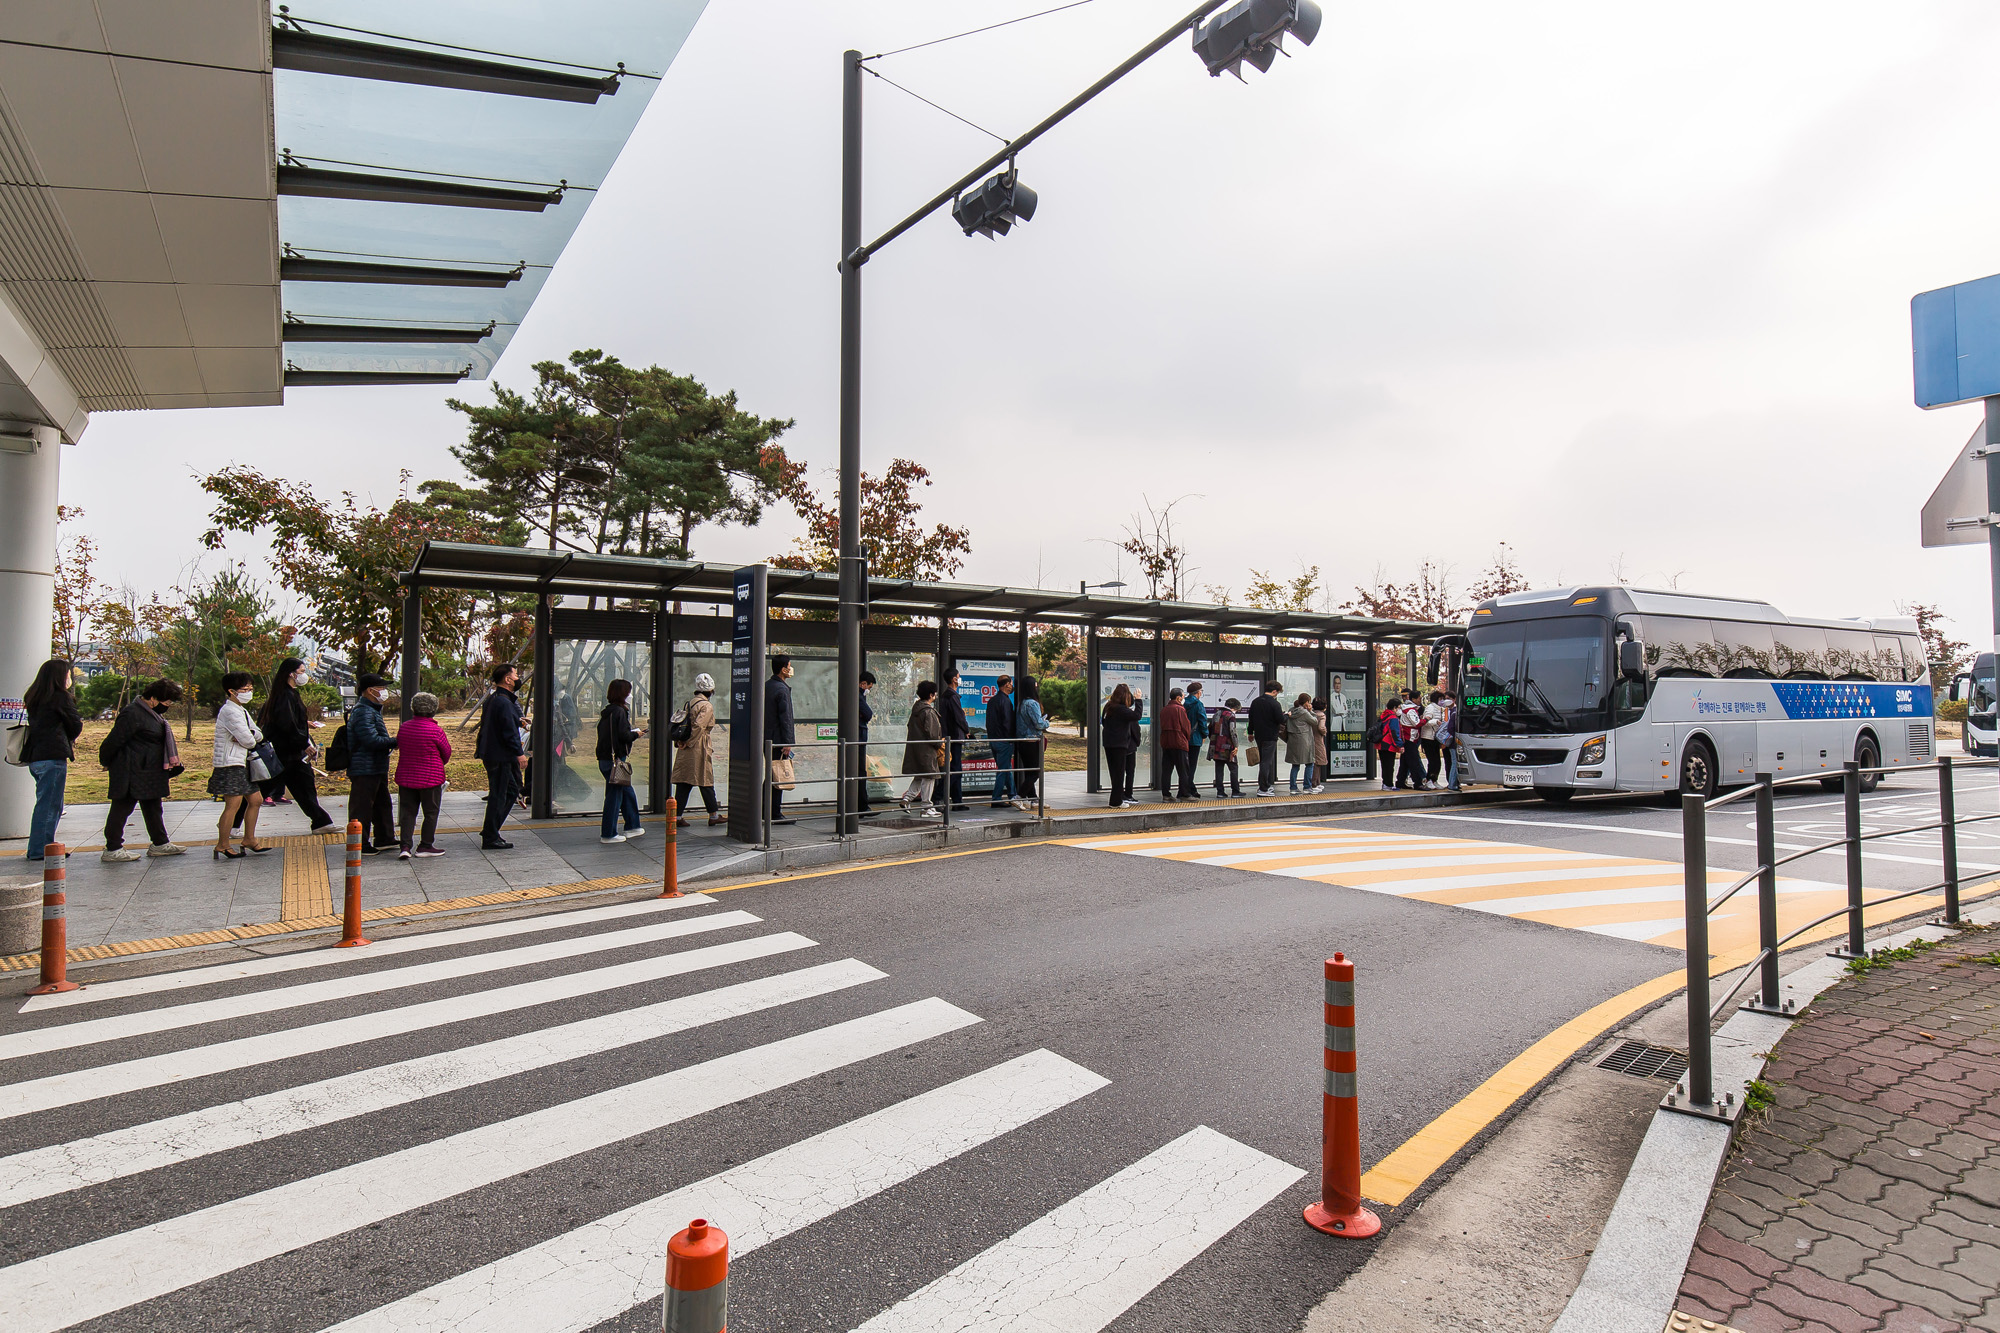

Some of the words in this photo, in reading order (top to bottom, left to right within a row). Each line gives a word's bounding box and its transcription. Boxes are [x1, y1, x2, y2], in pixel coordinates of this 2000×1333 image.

[981, 685, 998, 705] 암
[1895, 689, 1913, 703] SMC
[1698, 702, 1721, 714] 함께하는
[1722, 702, 1734, 714] 진료
[1734, 702, 1756, 714] 함께하는
[1756, 701, 1767, 714] 행복
